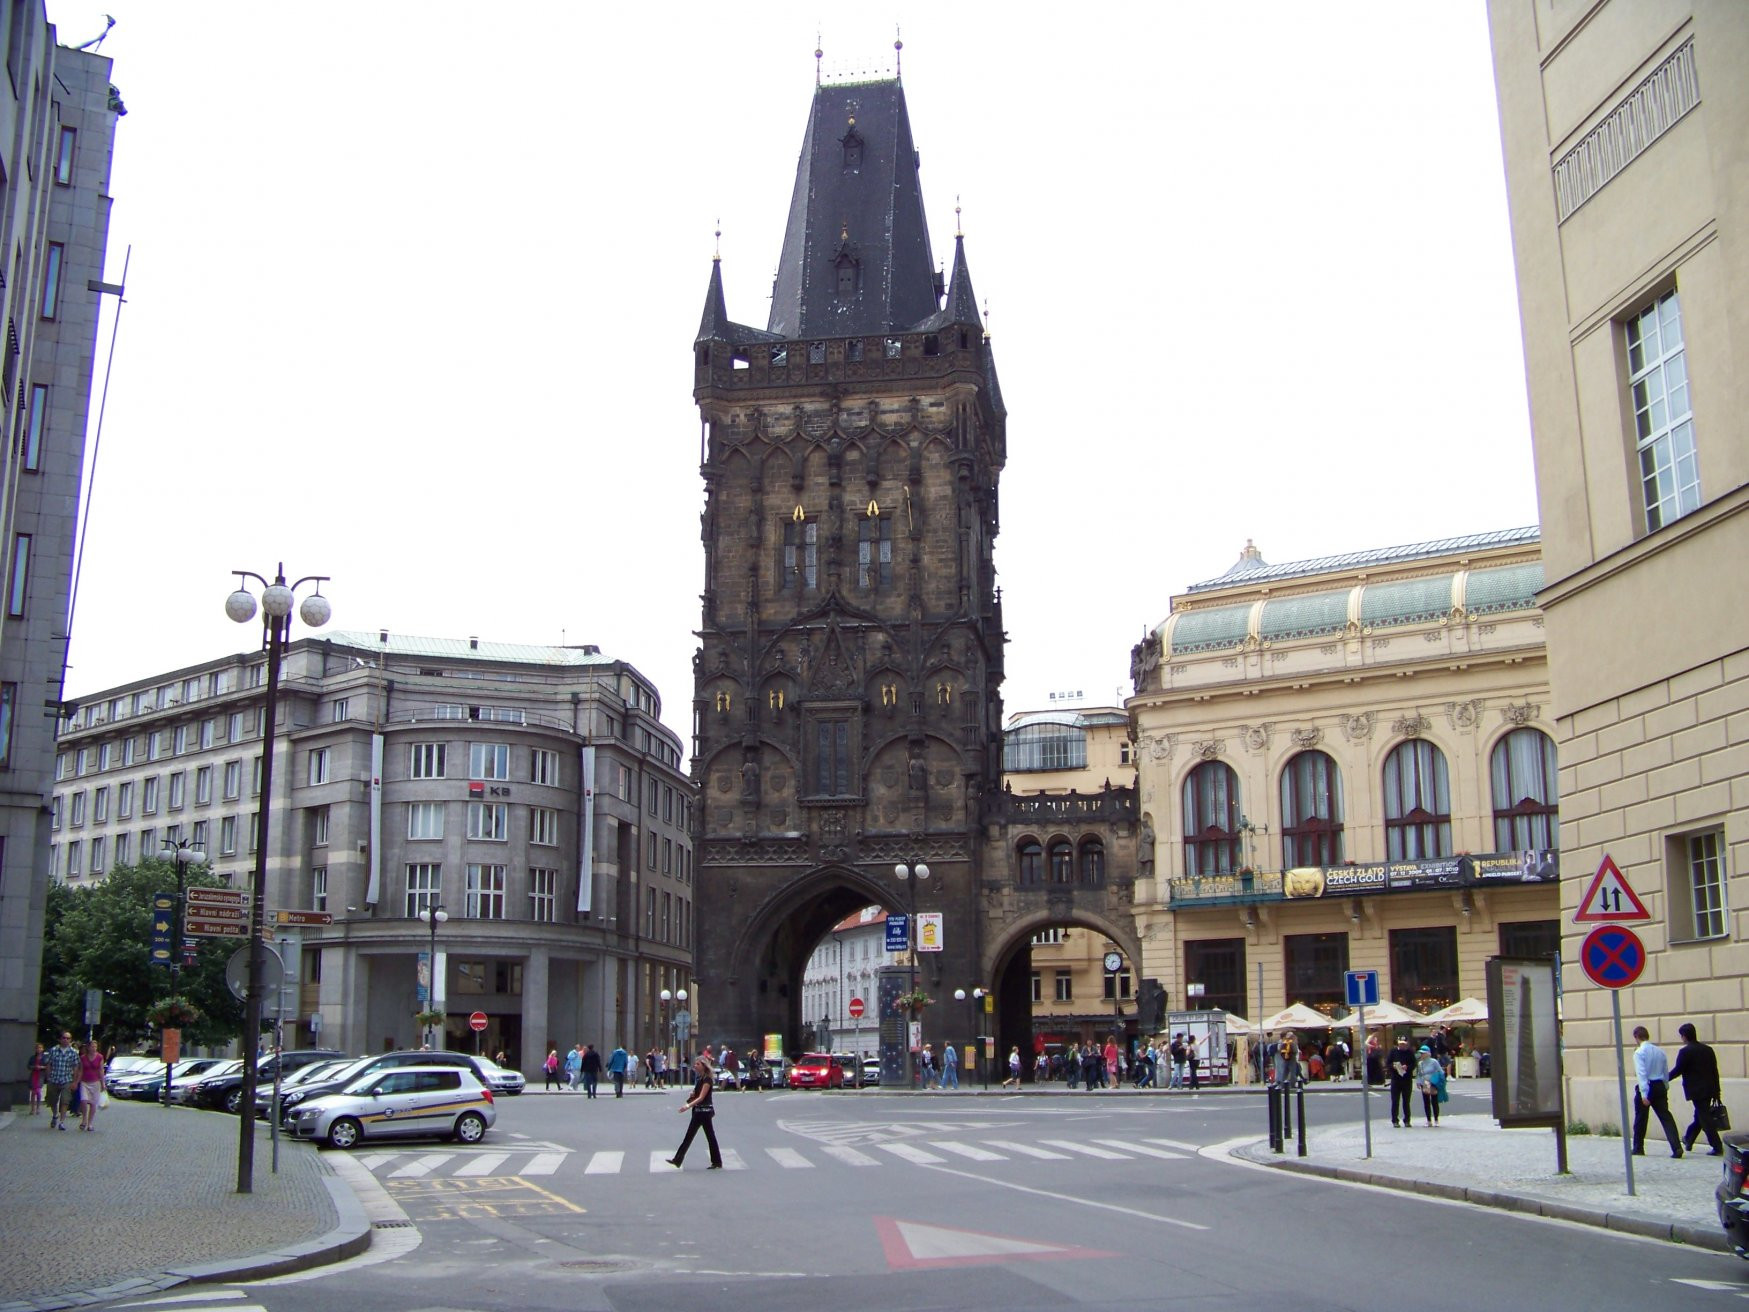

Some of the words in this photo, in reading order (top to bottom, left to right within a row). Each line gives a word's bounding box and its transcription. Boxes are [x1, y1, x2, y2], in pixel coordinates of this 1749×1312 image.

[490, 786, 511, 796] KB
[1481, 859, 1522, 867] REPUBLIKA
[1326, 867, 1356, 878] ČESKÉ
[1356, 866, 1385, 876] ZLATO
[1326, 875, 1357, 885] CZECH
[1358, 873, 1385, 883] GOLD
[288, 914, 306, 922] Metro
